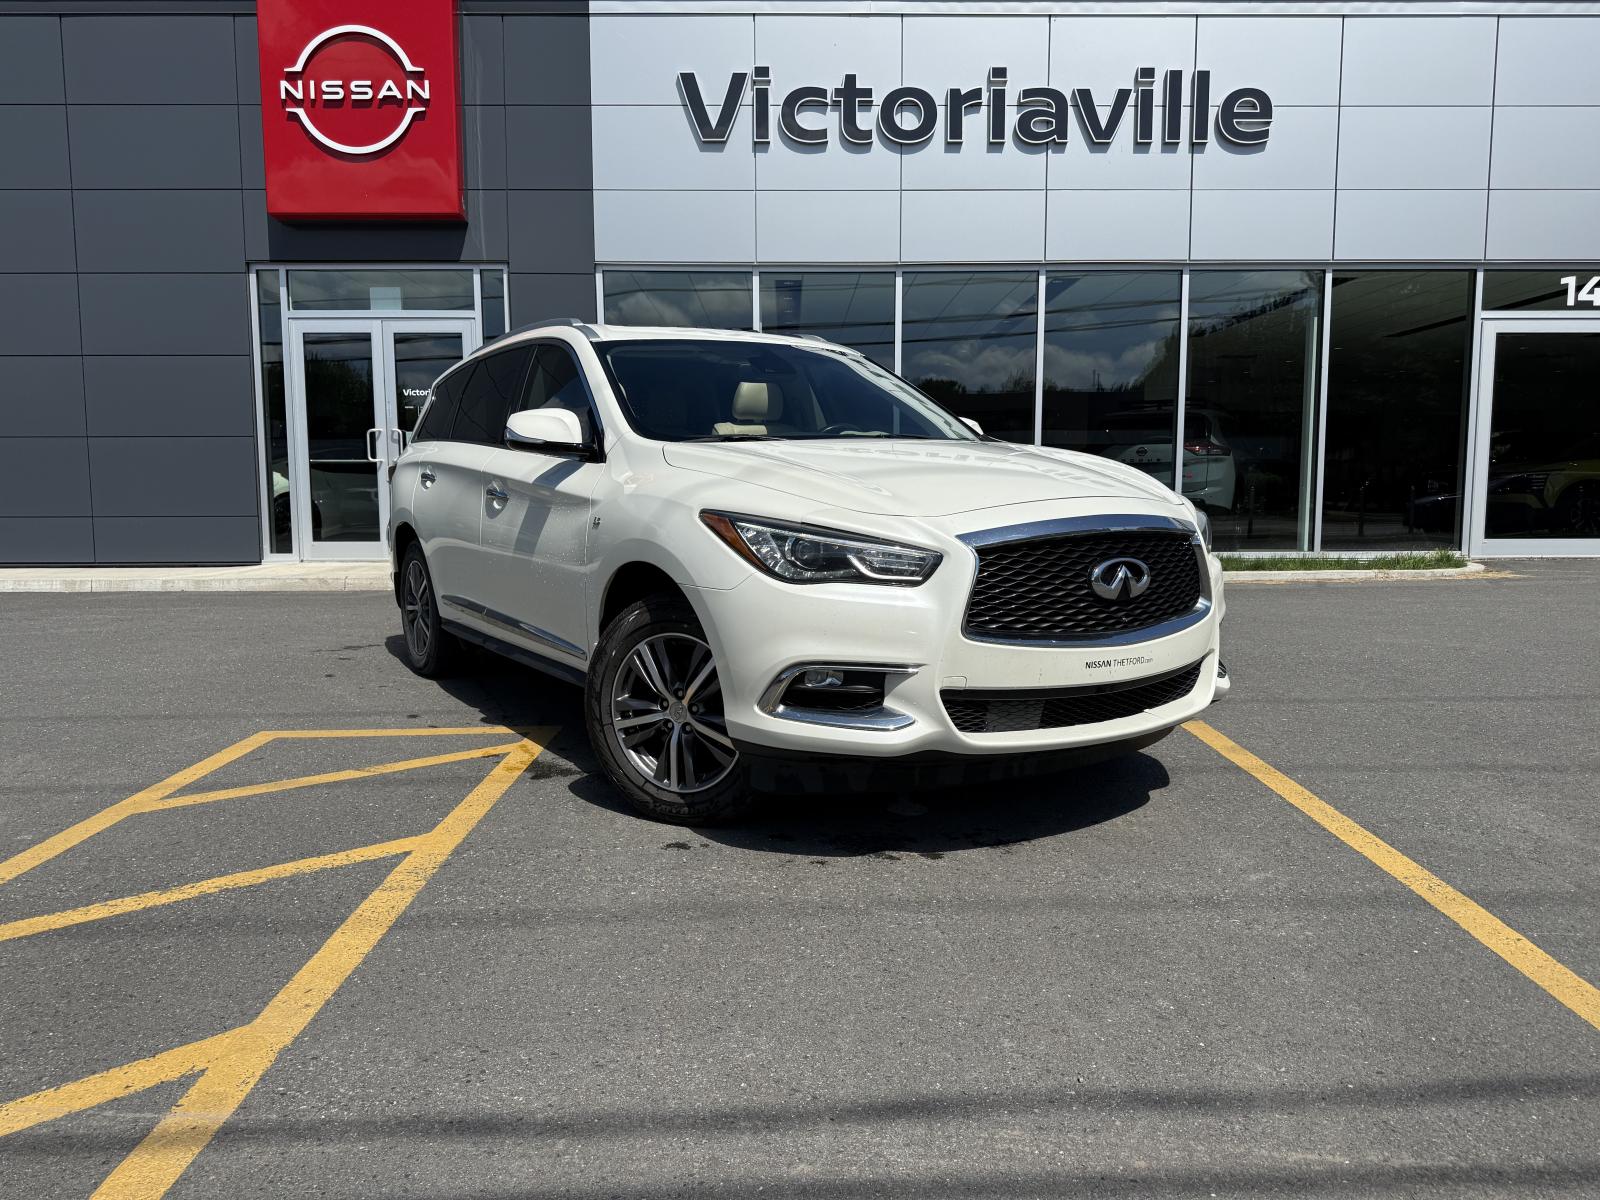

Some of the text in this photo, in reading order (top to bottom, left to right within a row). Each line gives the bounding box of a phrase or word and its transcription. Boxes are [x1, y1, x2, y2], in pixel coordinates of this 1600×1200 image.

[280, 79, 430, 100] NISSAN
[677, 65, 1273, 144] Victoriaville
[1560, 275, 1600, 306] 14
[1085, 659, 1112, 669] NISSAN
